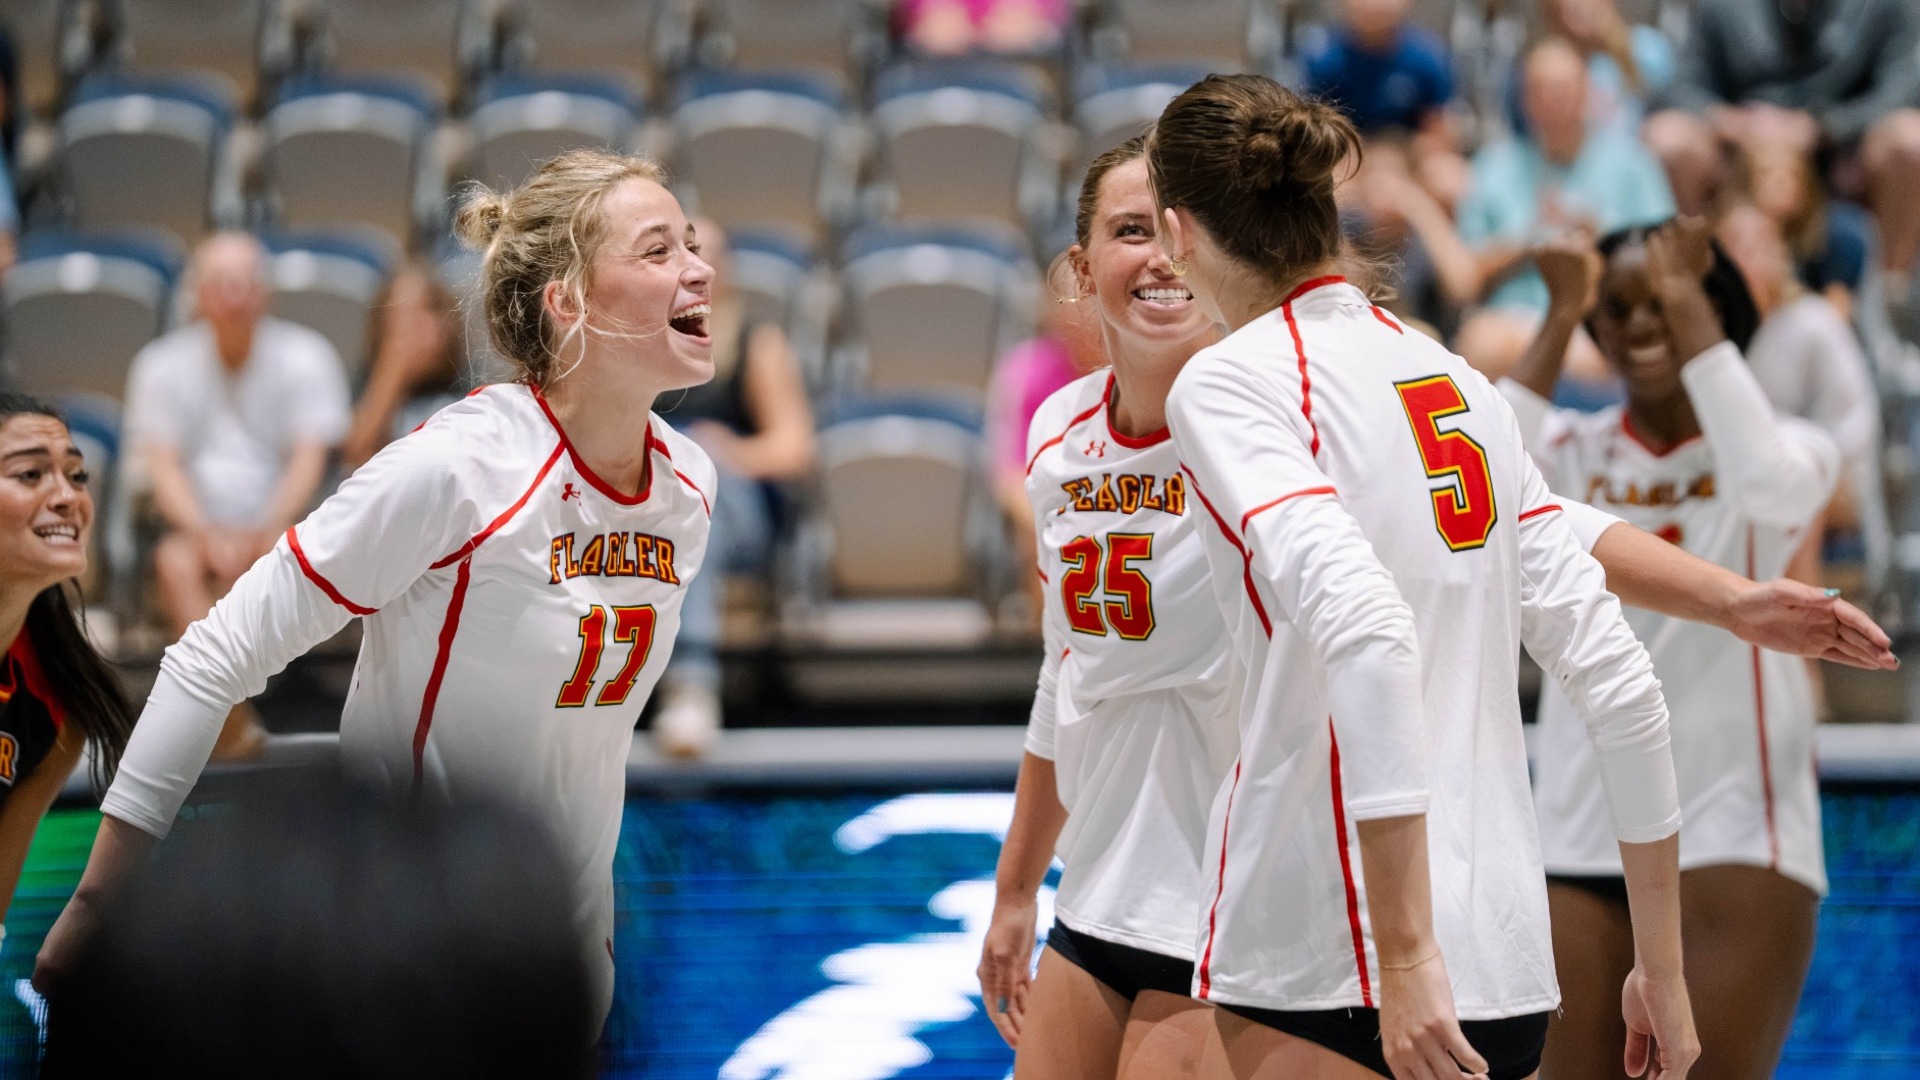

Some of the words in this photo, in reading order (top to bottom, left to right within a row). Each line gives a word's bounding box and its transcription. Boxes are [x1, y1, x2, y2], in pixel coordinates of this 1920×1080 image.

[1392, 373, 1498, 553] 5
[549, 531, 681, 586] FLAGLER
[1060, 532, 1156, 641] 25
[555, 604, 657, 708] 17
